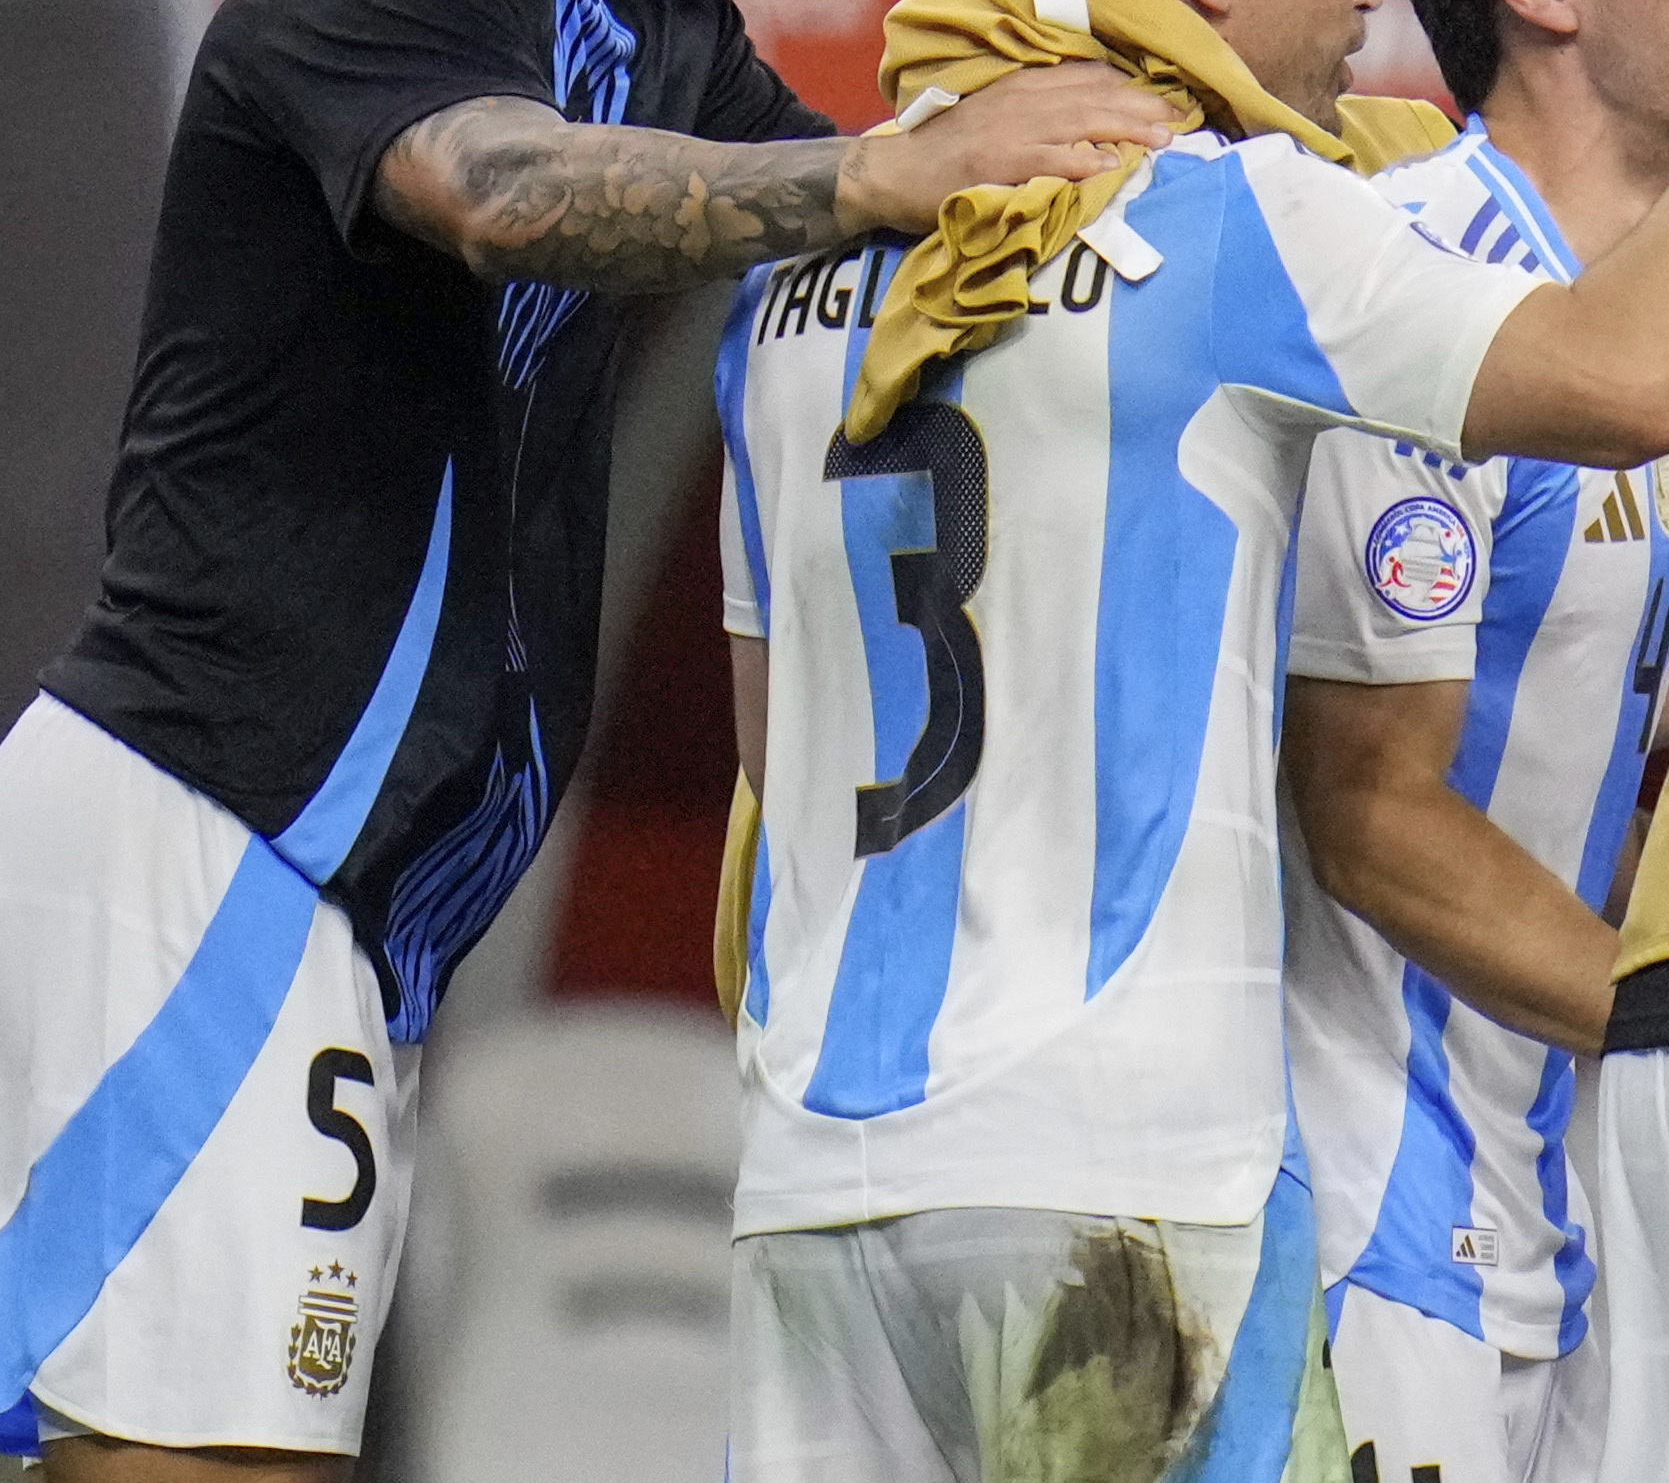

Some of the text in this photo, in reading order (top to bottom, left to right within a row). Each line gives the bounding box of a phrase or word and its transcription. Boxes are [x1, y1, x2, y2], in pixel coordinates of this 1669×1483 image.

[823, 403, 988, 860] 3
[300, 1046, 376, 1231] 5
[303, 1321, 343, 1369] AFA
